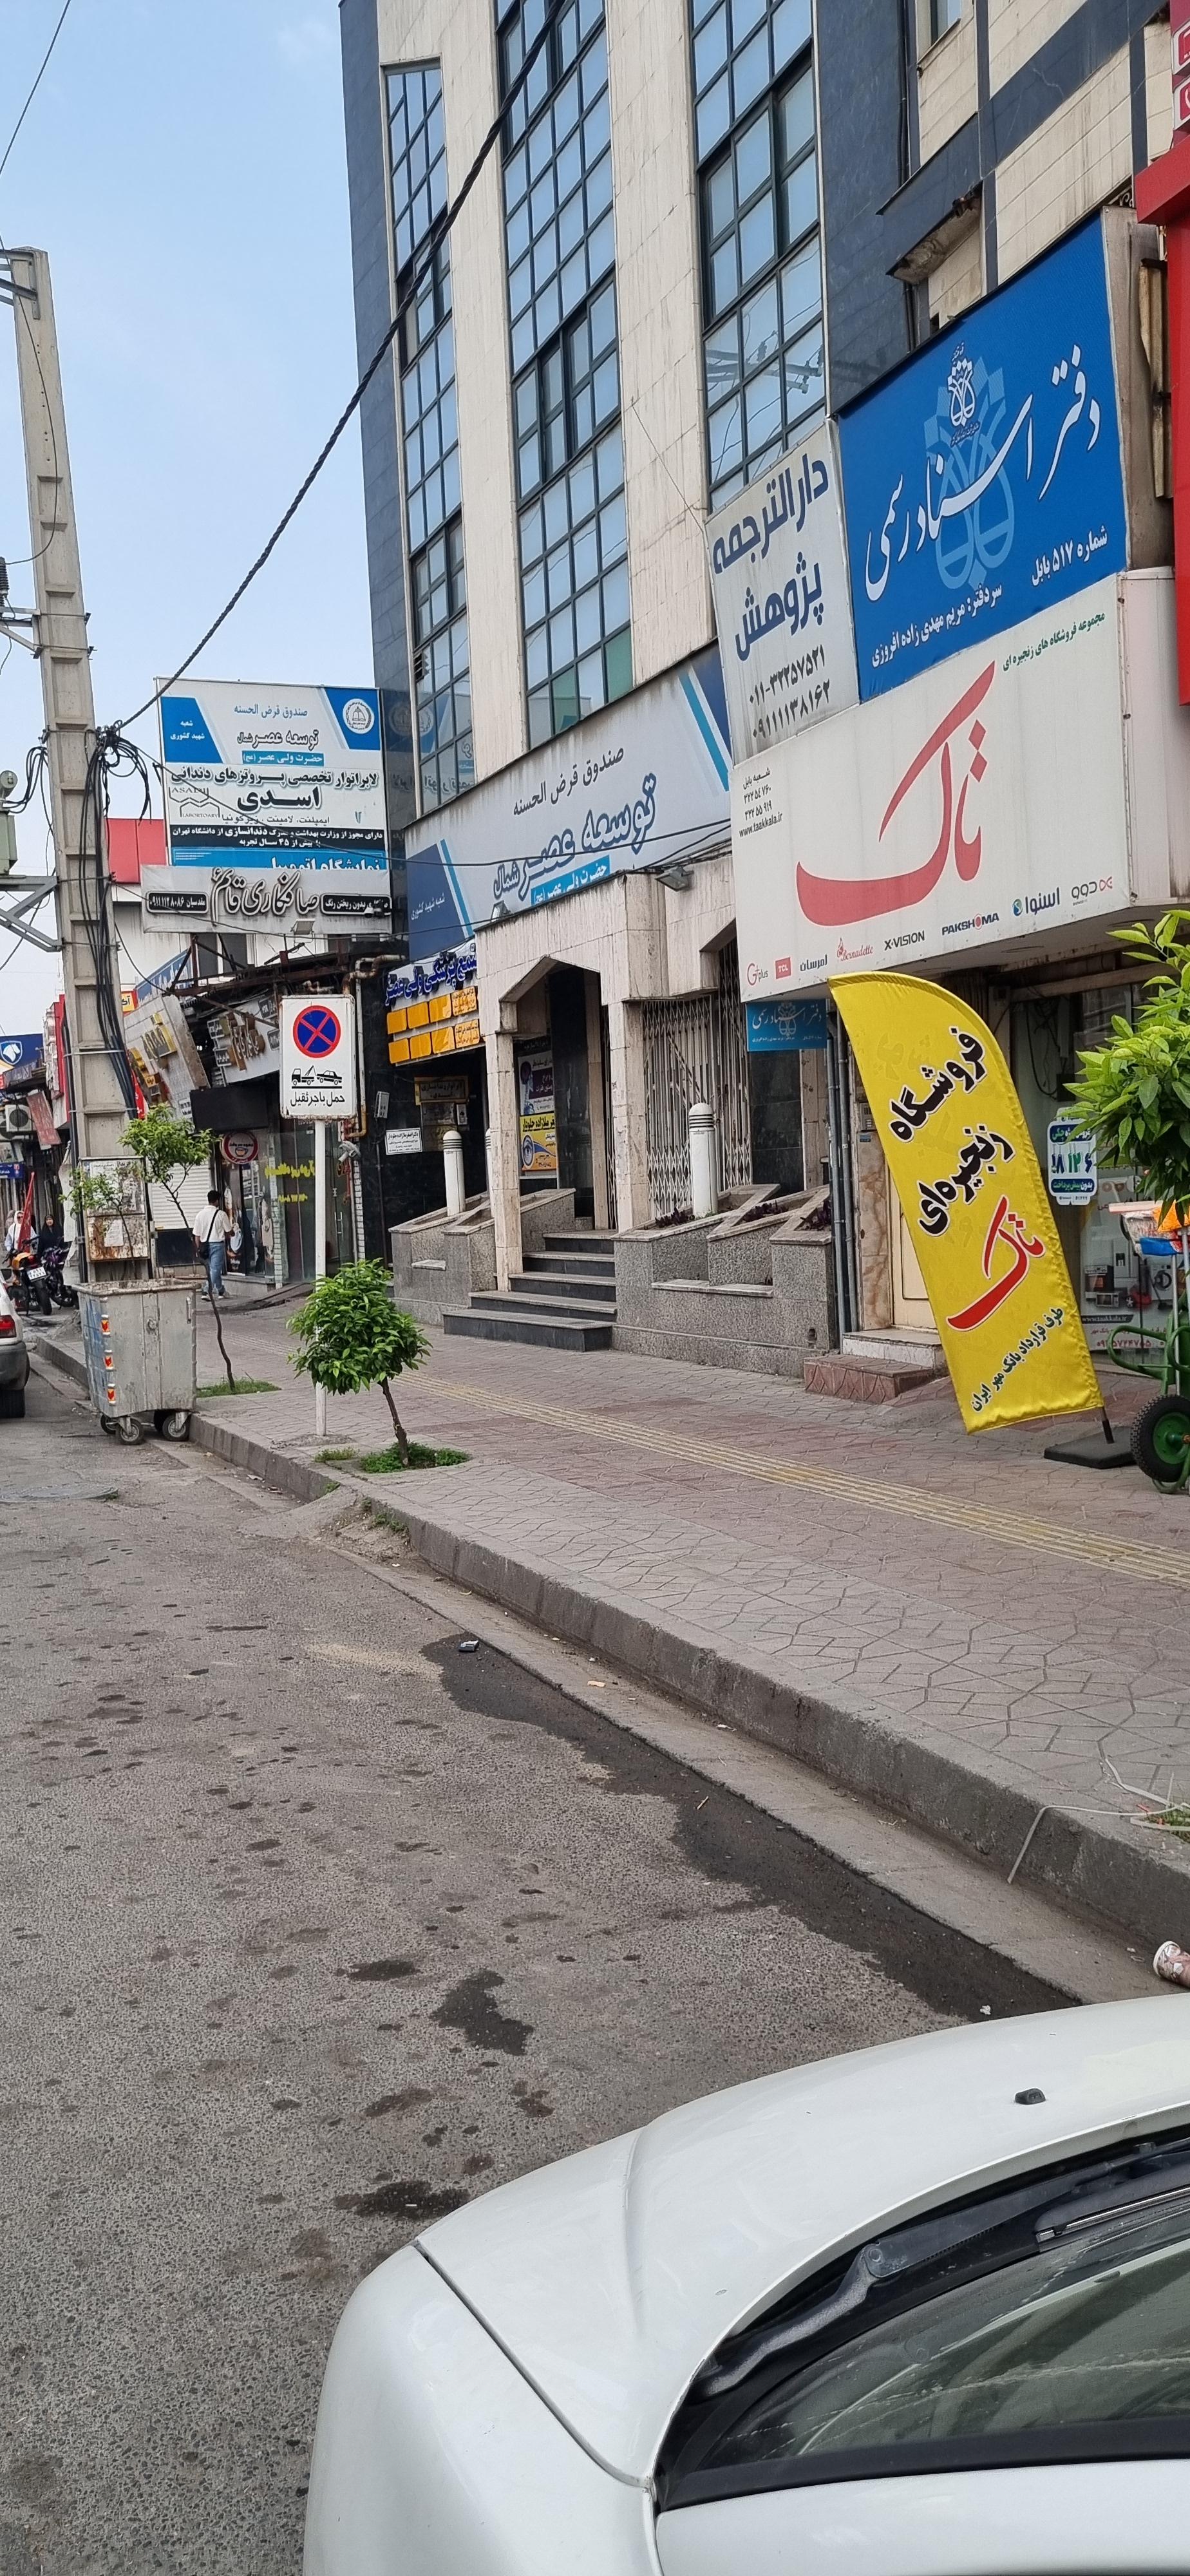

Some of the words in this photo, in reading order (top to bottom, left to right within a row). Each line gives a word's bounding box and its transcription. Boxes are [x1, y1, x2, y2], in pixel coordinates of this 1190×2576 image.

[1038, 344, 1100, 501] دفتر
[916, 393, 1033, 551] اسناد
[865, 473, 910, 601] رسمی
[1077, 525, 1108, 562] شماره
[1052, 540, 1074, 572] ۵۱۷
[1031, 556, 1051, 586] بابل
[735, 551, 825, 662] پژوهش
[946, 601, 965, 630] مریم
[921, 615, 945, 642] مهدی
[1050, 621, 1078, 645] فروشگاه
[1078, 612, 1106, 632] مجموعه
[901, 623, 919, 647] زاده
[1035, 636, 1049, 657] های
[234, 703, 259, 715] الحسنه
[261, 705, 281, 719] قرض
[282, 709, 308, 719] صندوق
[753, 677, 831, 739] ۰۹۱۱۱۱۳۸۱۶۲
[191, 732, 205, 741] شهید
[252, 731, 283, 748] عصر
[286, 730, 319, 750] توسعه
[257, 753, 275, 764] عصر
[276, 752, 294, 764] ولی
[295, 753, 322, 764] حضرت
[582, 748, 624, 786] صندوق
[171, 766, 211, 782] دندانی
[288, 770, 332, 785] تخصصی
[335, 772, 379, 789] لابراتوار
[551, 764, 578, 805] قرض
[743, 776, 752, 790] بابل
[753, 767, 770, 784] شعبه
[237, 786, 321, 812] اسدی
[513, 780, 547, 816] الحسنه
[796, 661, 996, 926] تاک
[581, 772, 657, 855] توسعه
[739, 811, 783, 838] www.taakkala.ir
[172, 828, 191, 836] تهران
[216, 828, 223, 836] از
[225, 827, 268, 837] دندانسازی
[259, 838, 278, 847] سال
[295, 829, 319, 838] بهداشت
[319, 830, 339, 839] وزارت
[340, 831, 347, 839] از
[348, 831, 364, 840] مجوز
[364, 831, 383, 840] دارای
[292, 839, 298, 848] از
[518, 828, 576, 901] عصر
[580, 862, 608, 885] حضرت
[1025, 886, 1061, 916] اسنوا
[1071, 881, 1097, 900] دوو
[941, 912, 1000, 936] PAKSHOMA
[800, 954, 828, 971] امرسان
[806, 1003, 822, 1026] دفتر
[889, 1026, 987, 1142] فروشگاه
[290, 1091, 319, 1107] جرثقیل
[326, 1091, 345, 1107] حمل
[947, 1196, 1045, 1331] تاک
[1044, 1307, 1064, 1329] طرف
[1018, 1323, 1046, 1356] قرارداد
[1002, 1351, 1026, 1374] بانک
[992, 1370, 1005, 1392] مهر
[971, 1383, 992, 1413] ایران
